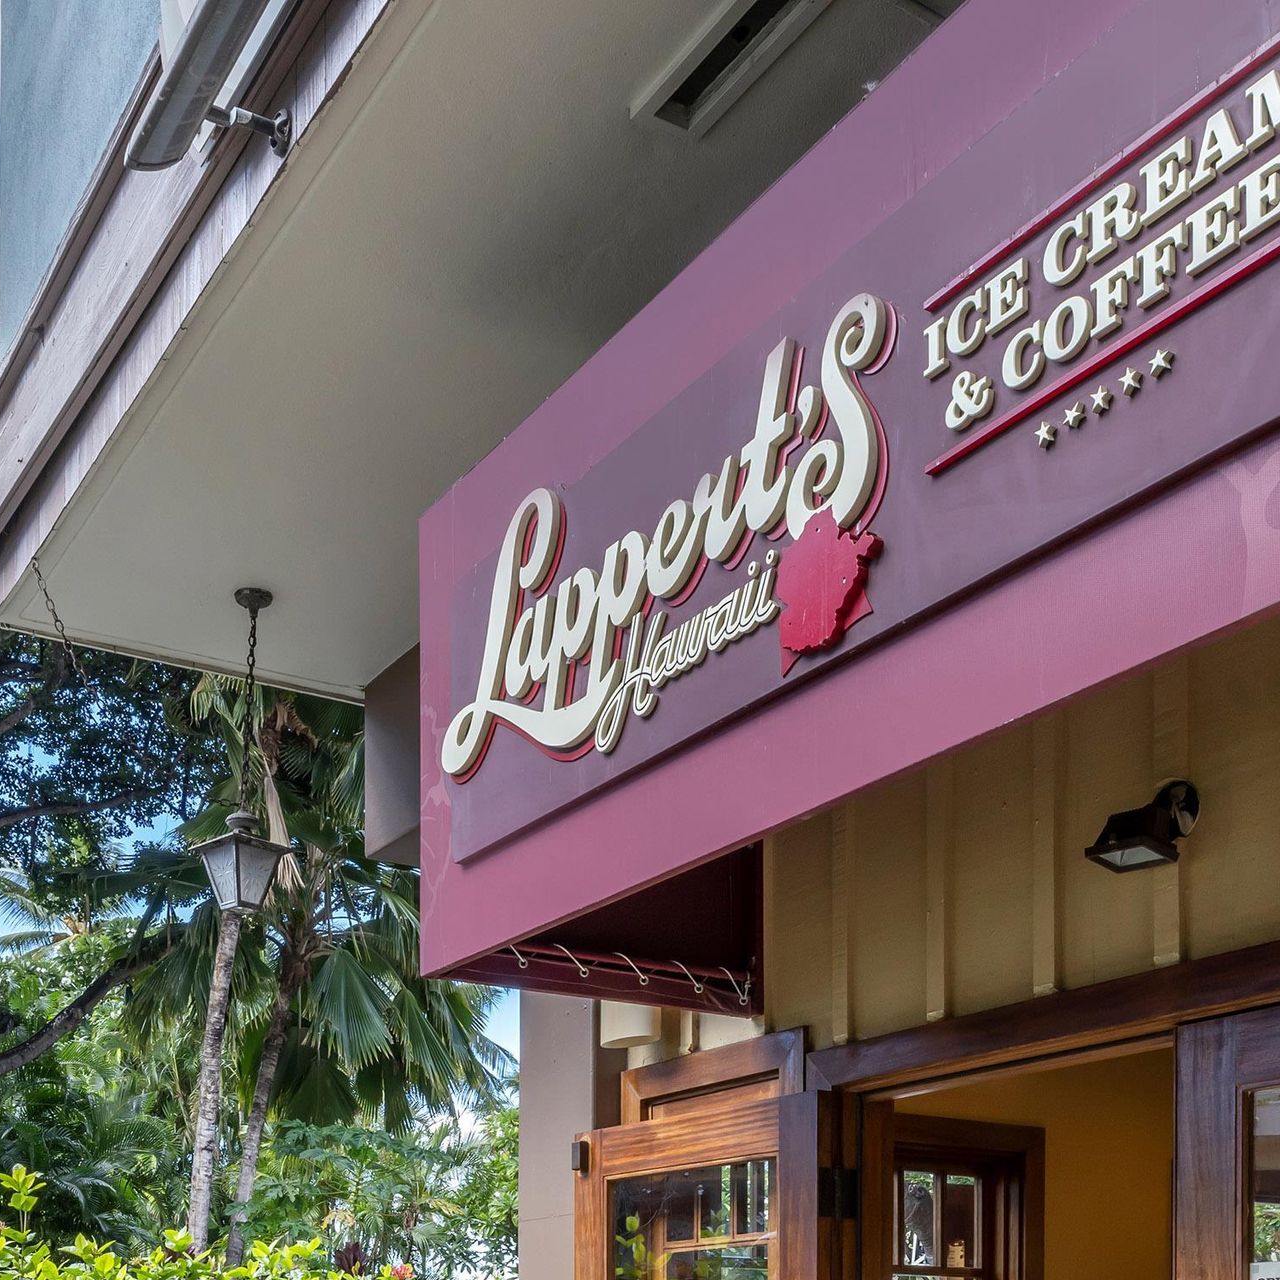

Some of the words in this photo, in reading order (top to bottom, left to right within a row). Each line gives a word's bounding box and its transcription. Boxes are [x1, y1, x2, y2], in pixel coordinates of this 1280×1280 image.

[923, 257, 1029, 380] ICE
[945, 370, 995, 433] &
[595, 548, 780, 754] Hawaii
